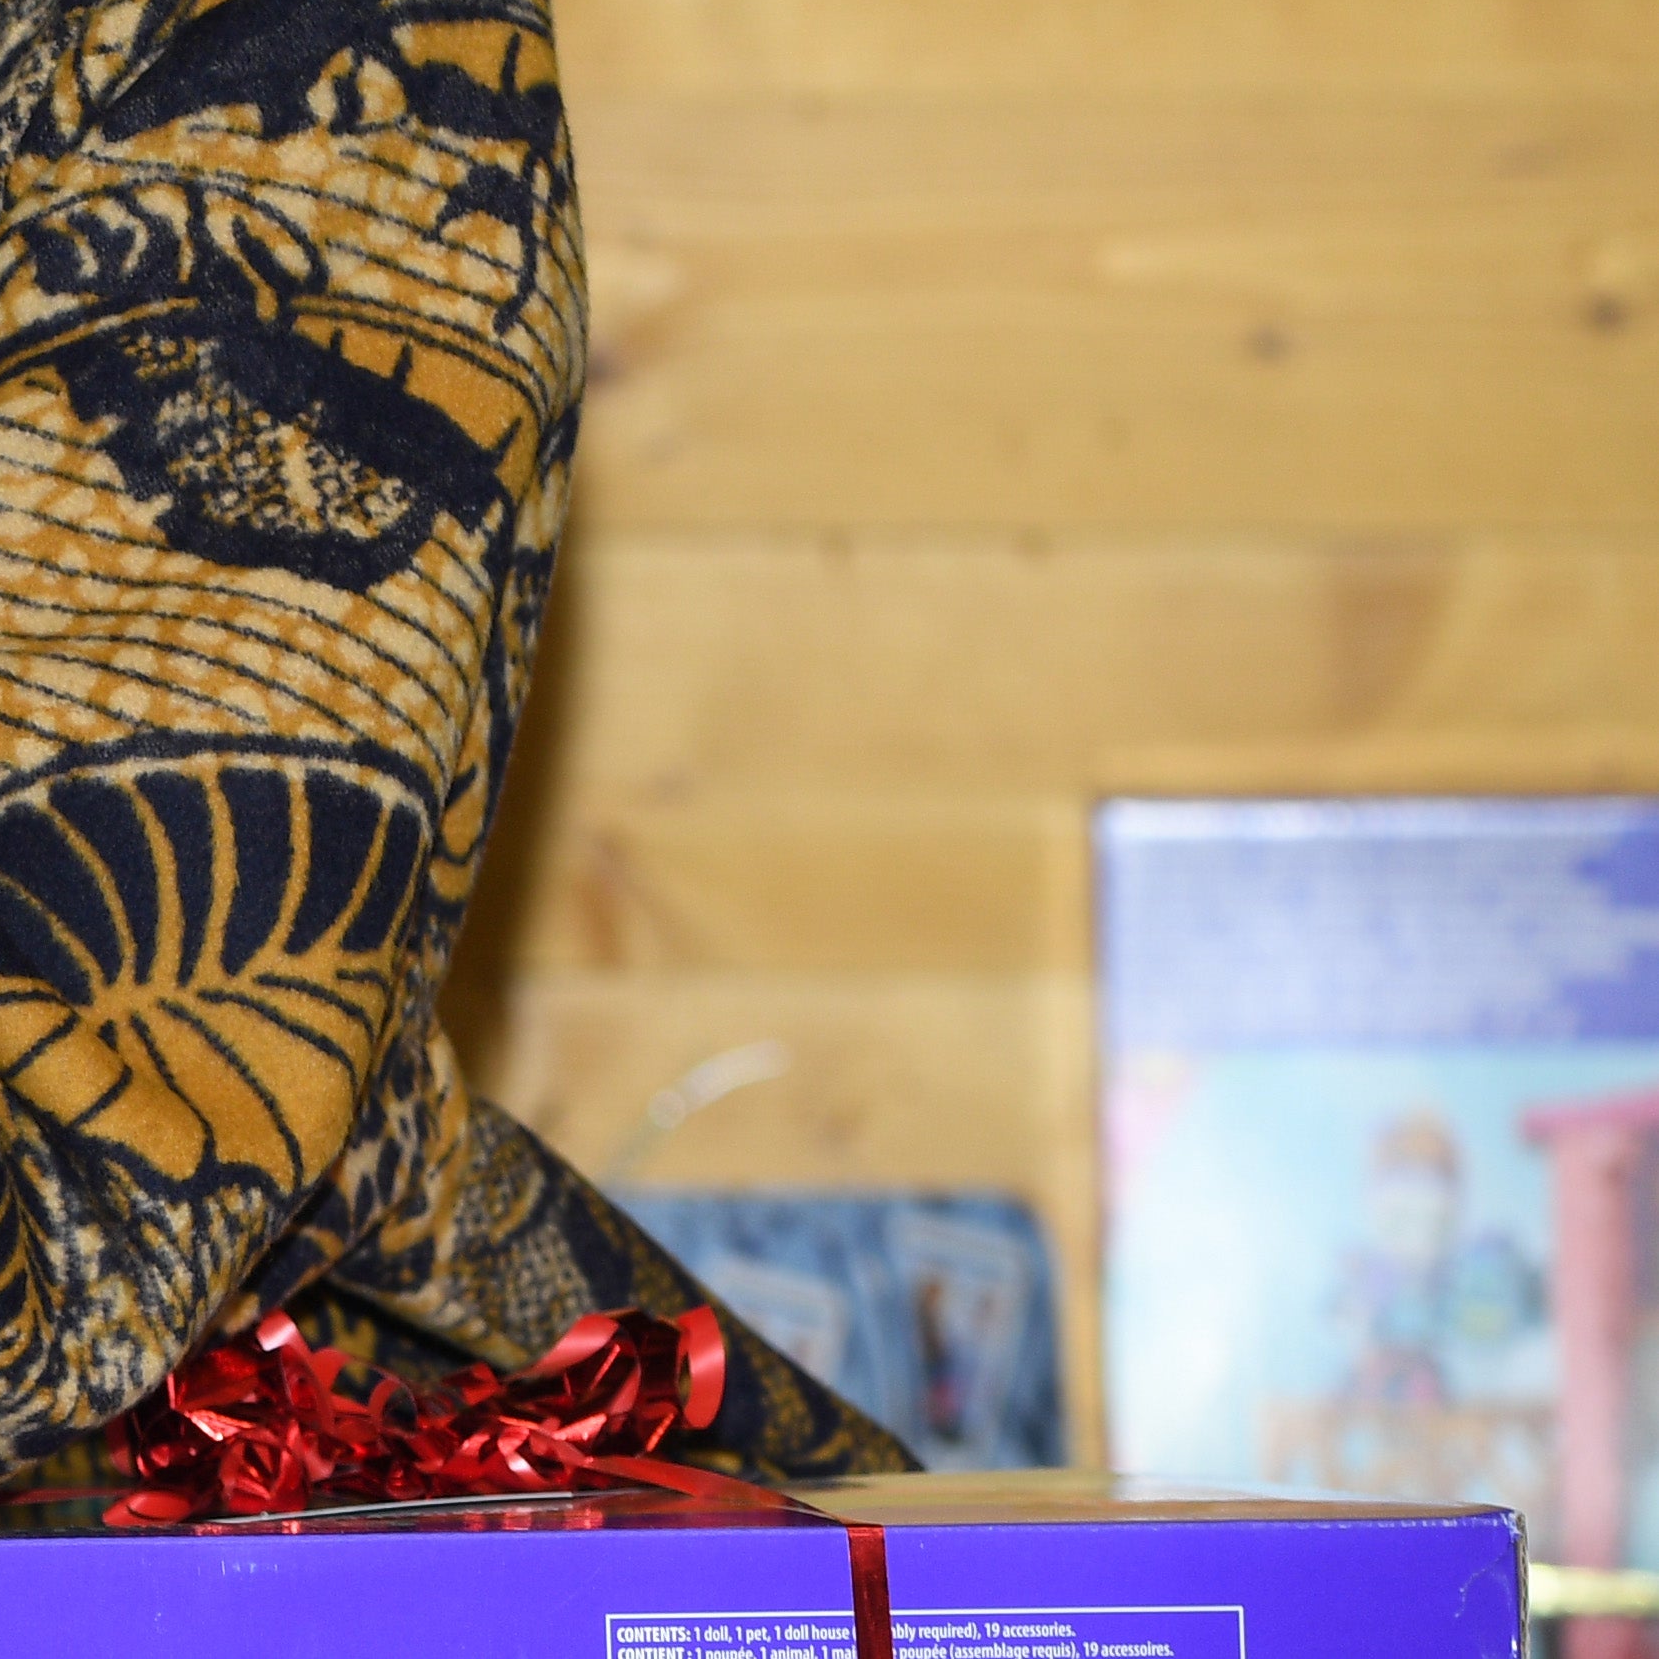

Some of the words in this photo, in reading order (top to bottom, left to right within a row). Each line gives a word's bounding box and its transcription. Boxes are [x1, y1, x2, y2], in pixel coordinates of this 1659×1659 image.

[617, 1626, 691, 1643] CONTENTS:
[694, 1627, 701, 1641] 1
[704, 1626, 732, 1643] doll,
[736, 1626, 742, 1641] 1
[746, 1627, 772, 1644] pet,
[774, 1626, 781, 1640] 1
[785, 1625, 810, 1640] doll
[811, 1625, 849, 1640] house
[919, 1622, 981, 1641] required),
[984, 1622, 1000, 1638] 19
[1003, 1622, 1076, 1638] accessories.
[899, 1643, 947, 1659] poupée
[1082, 1642, 1098, 1657] 19
[1101, 1641, 1174, 1657] accessoires.
